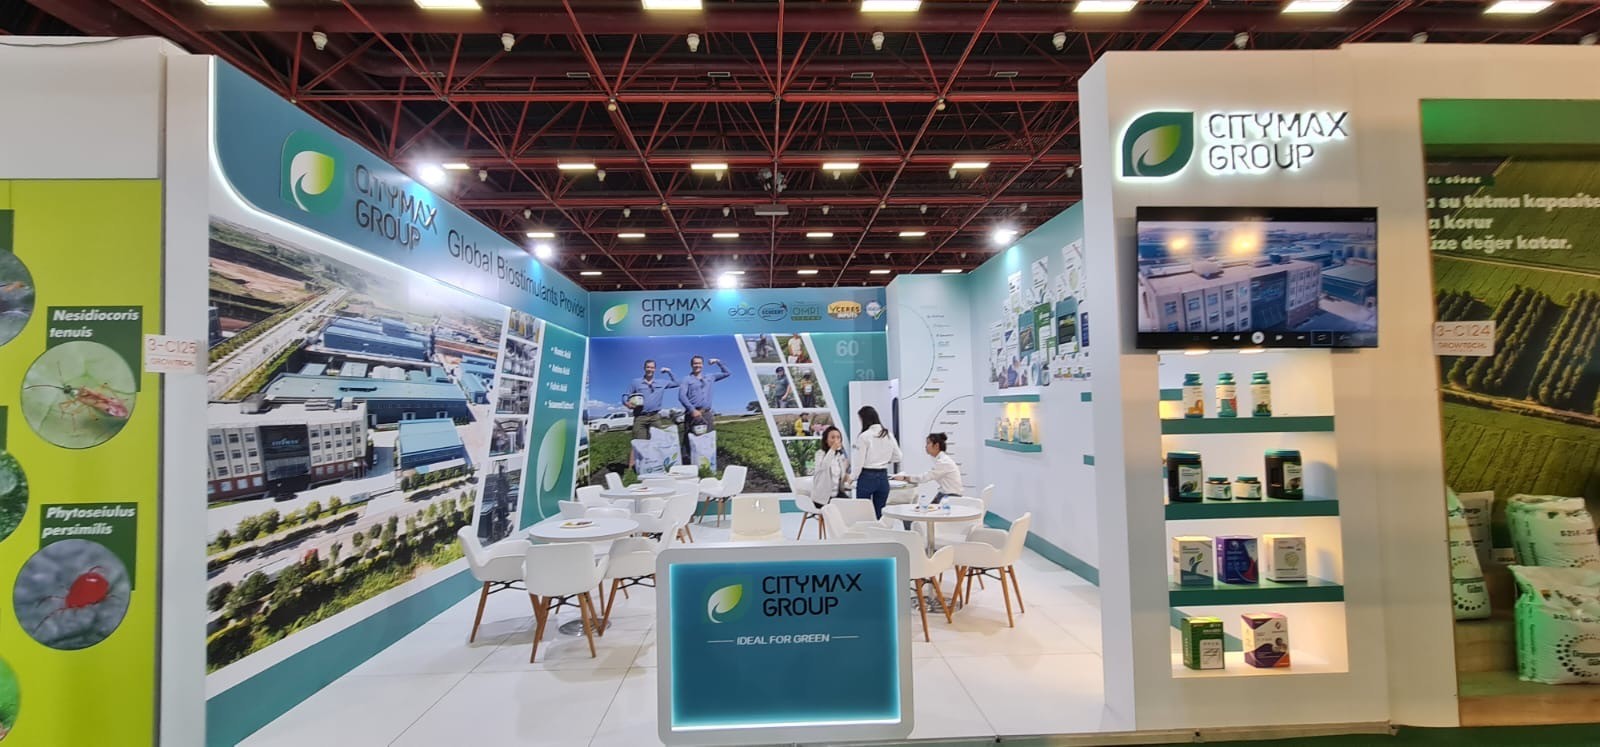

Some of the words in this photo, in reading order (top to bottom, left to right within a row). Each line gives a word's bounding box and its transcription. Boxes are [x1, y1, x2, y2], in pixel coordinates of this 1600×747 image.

[1208, 111, 1349, 139] CITYMAX
[1208, 143, 1315, 170] GROUP
[355, 163, 439, 235] CITYMAX
[1439, 197, 1460, 208] su
[1463, 194, 1520, 208] tutma
[355, 199, 421, 250] GROUP
[1443, 214, 1494, 229] korur
[1461, 235, 1514, 254] değer
[1516, 234, 1572, 249] katar.
[447, 229, 493, 275] Global
[497, 256, 559, 307] Biostimulants
[559, 291, 586, 319] Provider
[641, 298, 712, 313] CITYMAX
[53, 308, 140, 321] Nesidiocoris
[641, 313, 696, 327] GROUP
[49, 326, 93, 338] tenuis
[1436, 324, 1491, 337] 3-C124
[148, 338, 197, 354] 3-C125
[836, 340, 859, 357] 60
[46, 505, 136, 521] Phytoseiulus
[42, 523, 113, 538] persimilis
[762, 573, 863, 595] CITYMAX
[762, 596, 839, 617] GROUP
[736, 636, 768, 646] IDEAL
[769, 635, 792, 645] FOR
[793, 633, 830, 644] GREEN
